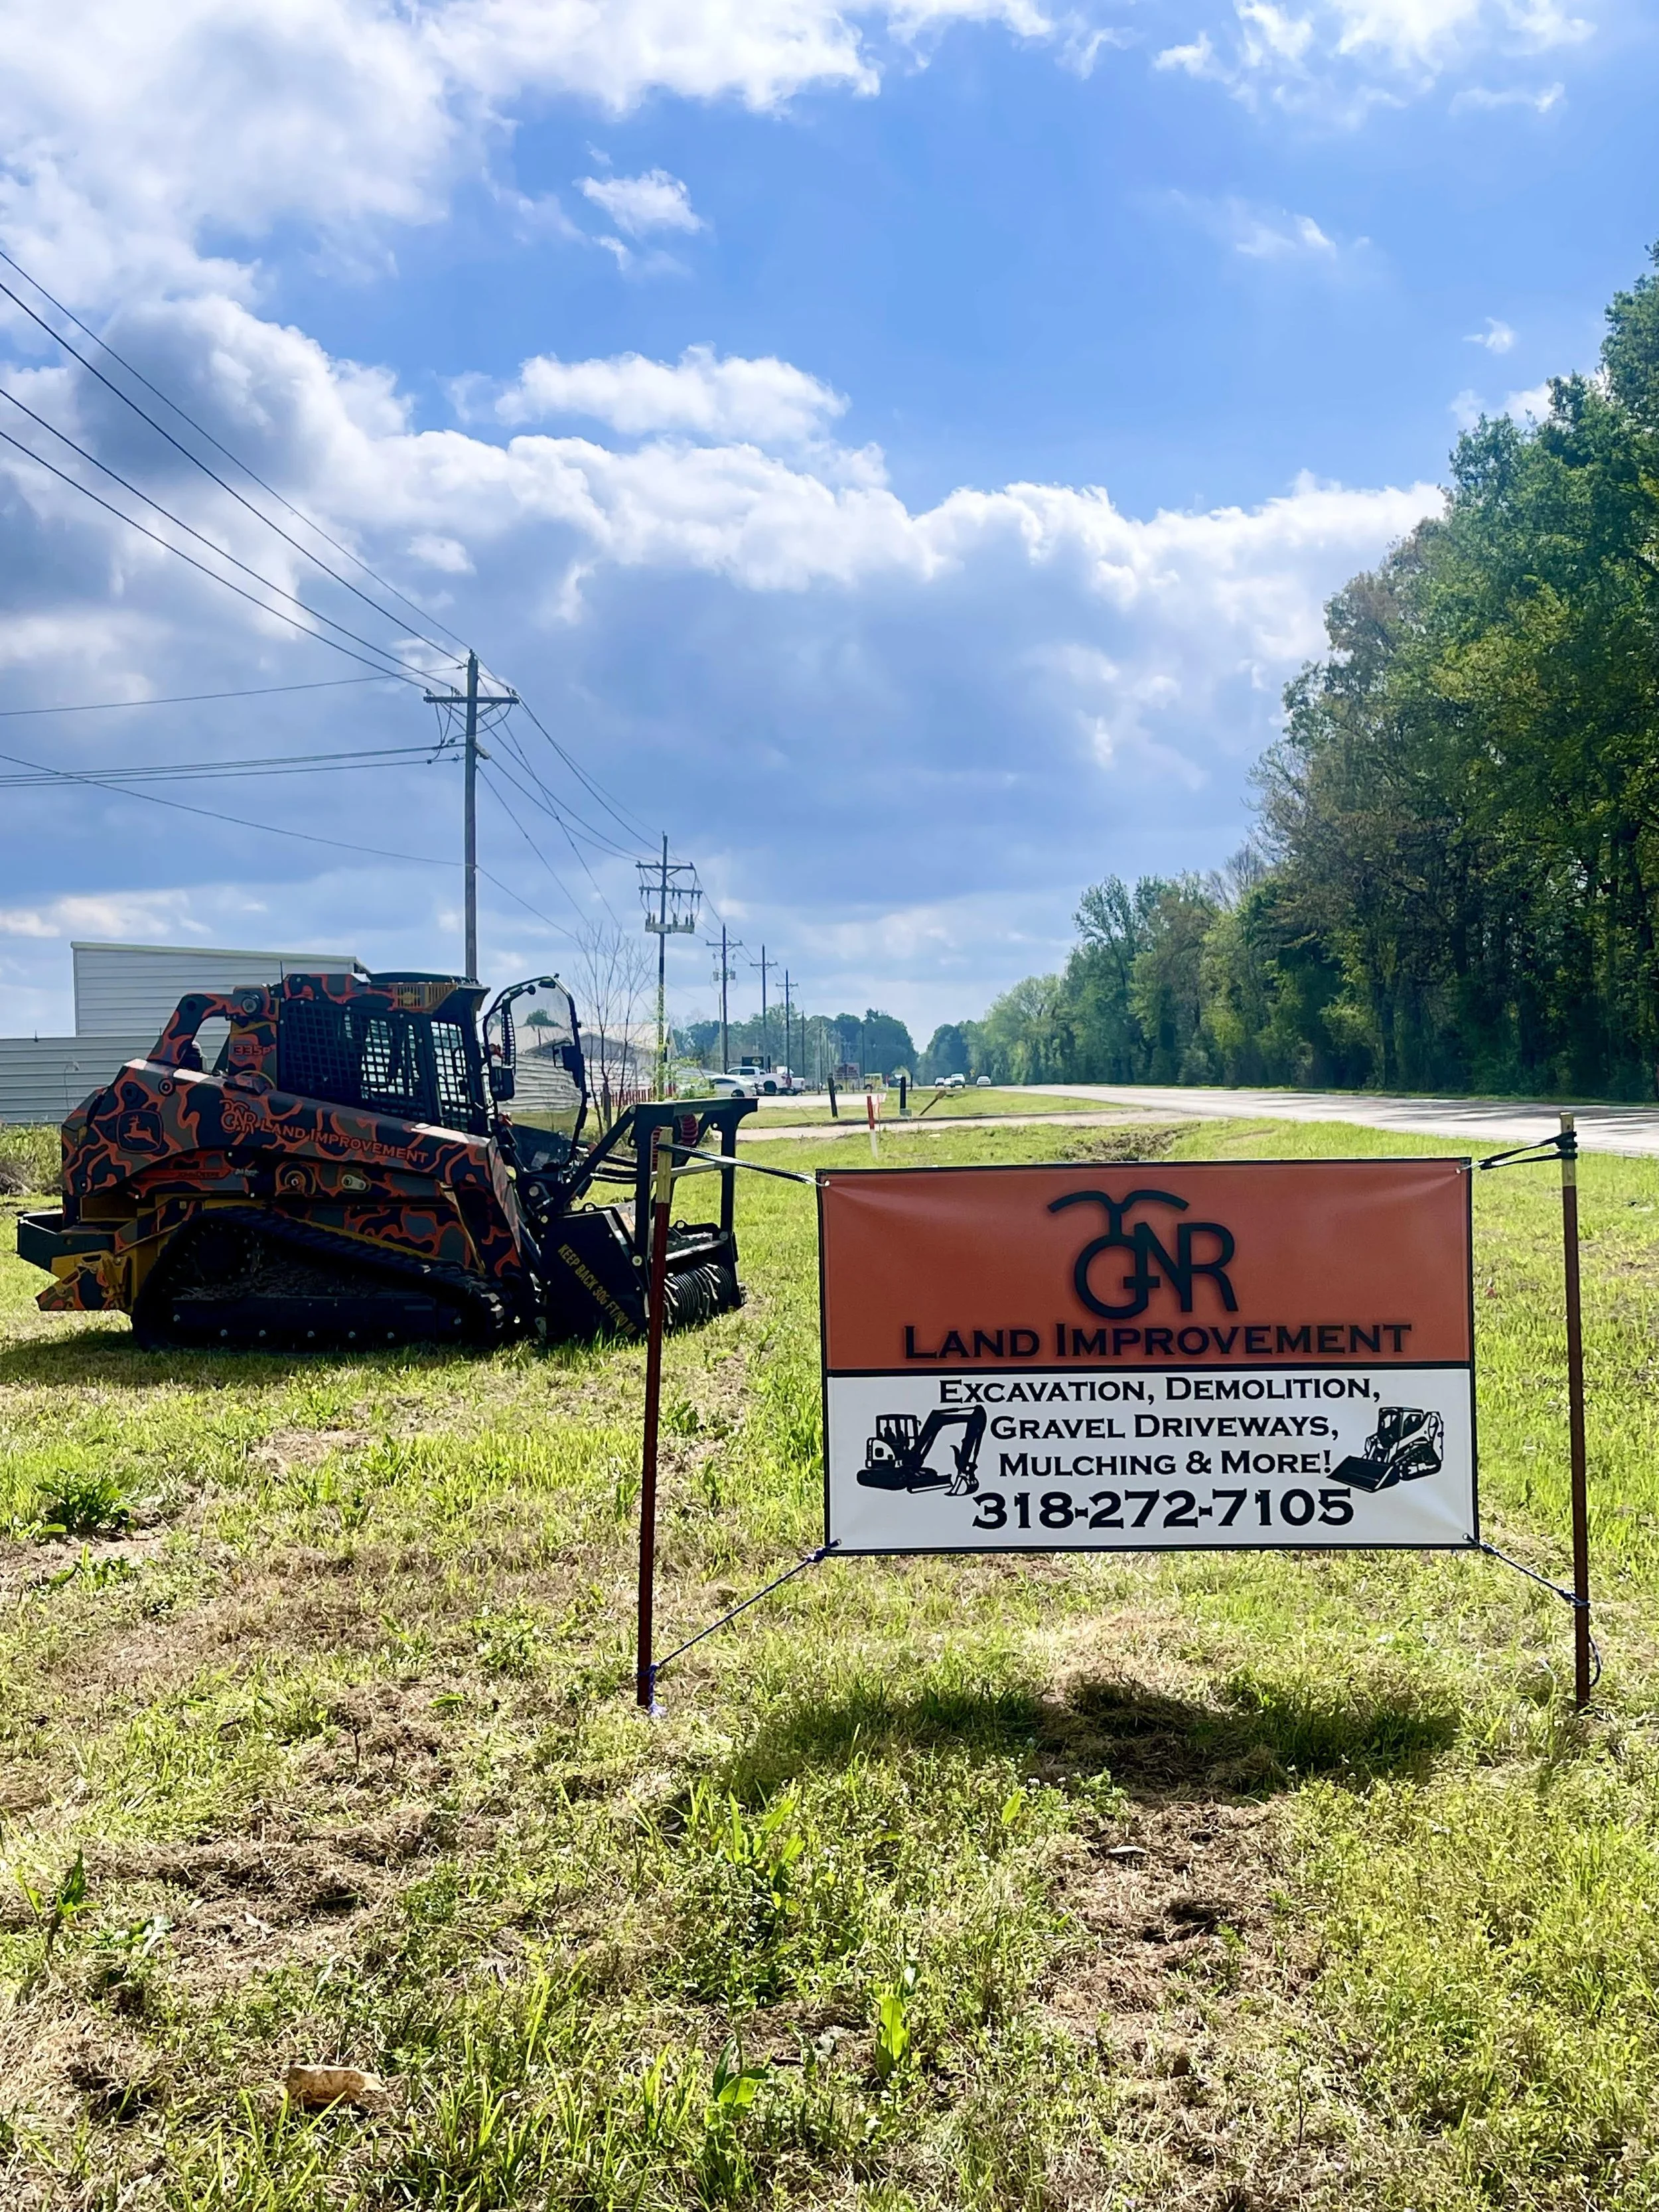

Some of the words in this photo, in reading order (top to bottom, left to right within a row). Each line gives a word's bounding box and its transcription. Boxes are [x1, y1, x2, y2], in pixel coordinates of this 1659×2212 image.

[259, 1119, 305, 1139] LAND
[310, 1128, 429, 1163] IMPROVEMENT
[557, 1244, 581, 1266] KEEP
[575, 1264, 599, 1290] BACK
[902, 1325, 1041, 1360] LAND
[1055, 1323, 1413, 1357] IMPROVEMENT
[940, 1378, 1155, 1405] EXCAVATION,
[1165, 1377, 1380, 1403] DEMOLITION,
[990, 1416, 1125, 1440] GRAVEL
[1134, 1414, 1338, 1441] DRIVEWAYS,
[999, 1453, 1177, 1477] MULCHING
[1186, 1451, 1211, 1475] &
[1220, 1449, 1331, 1474] MORE!
[972, 1488, 1354, 1530] 318-272-7105
